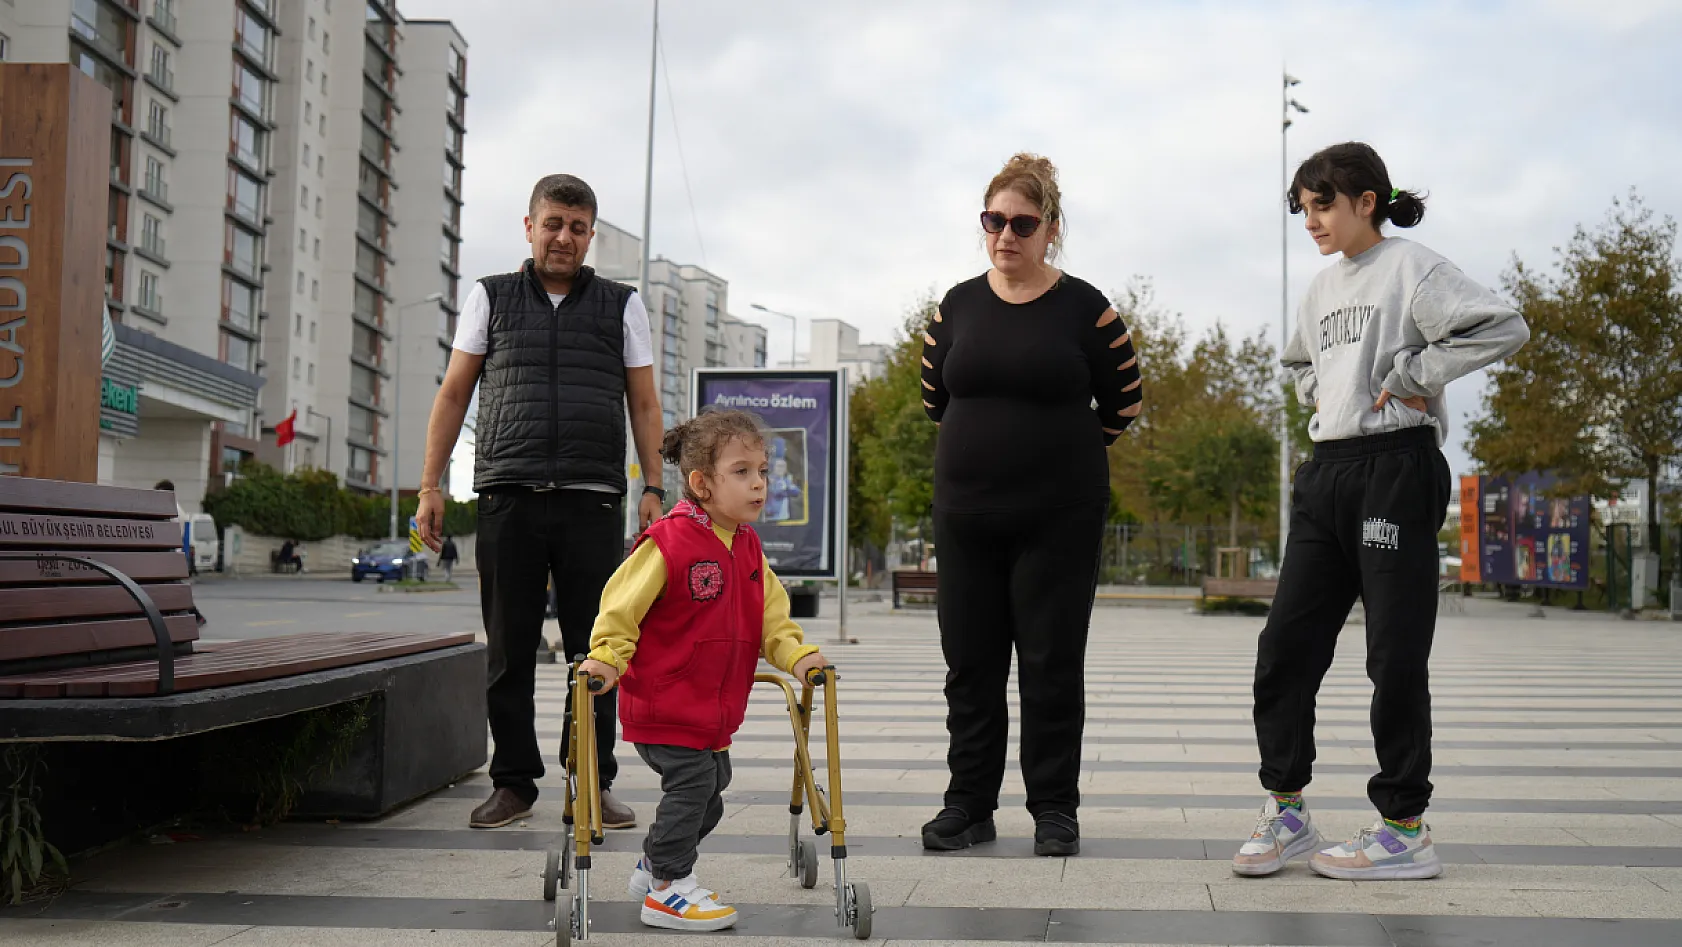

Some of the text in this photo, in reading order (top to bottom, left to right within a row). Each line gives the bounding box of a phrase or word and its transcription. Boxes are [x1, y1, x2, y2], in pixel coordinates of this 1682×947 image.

[771, 393, 817, 409] özlem
[21, 518, 95, 540] BÜYÜKŞEHİR
[96, 523, 154, 539] BELEDİYESİ
